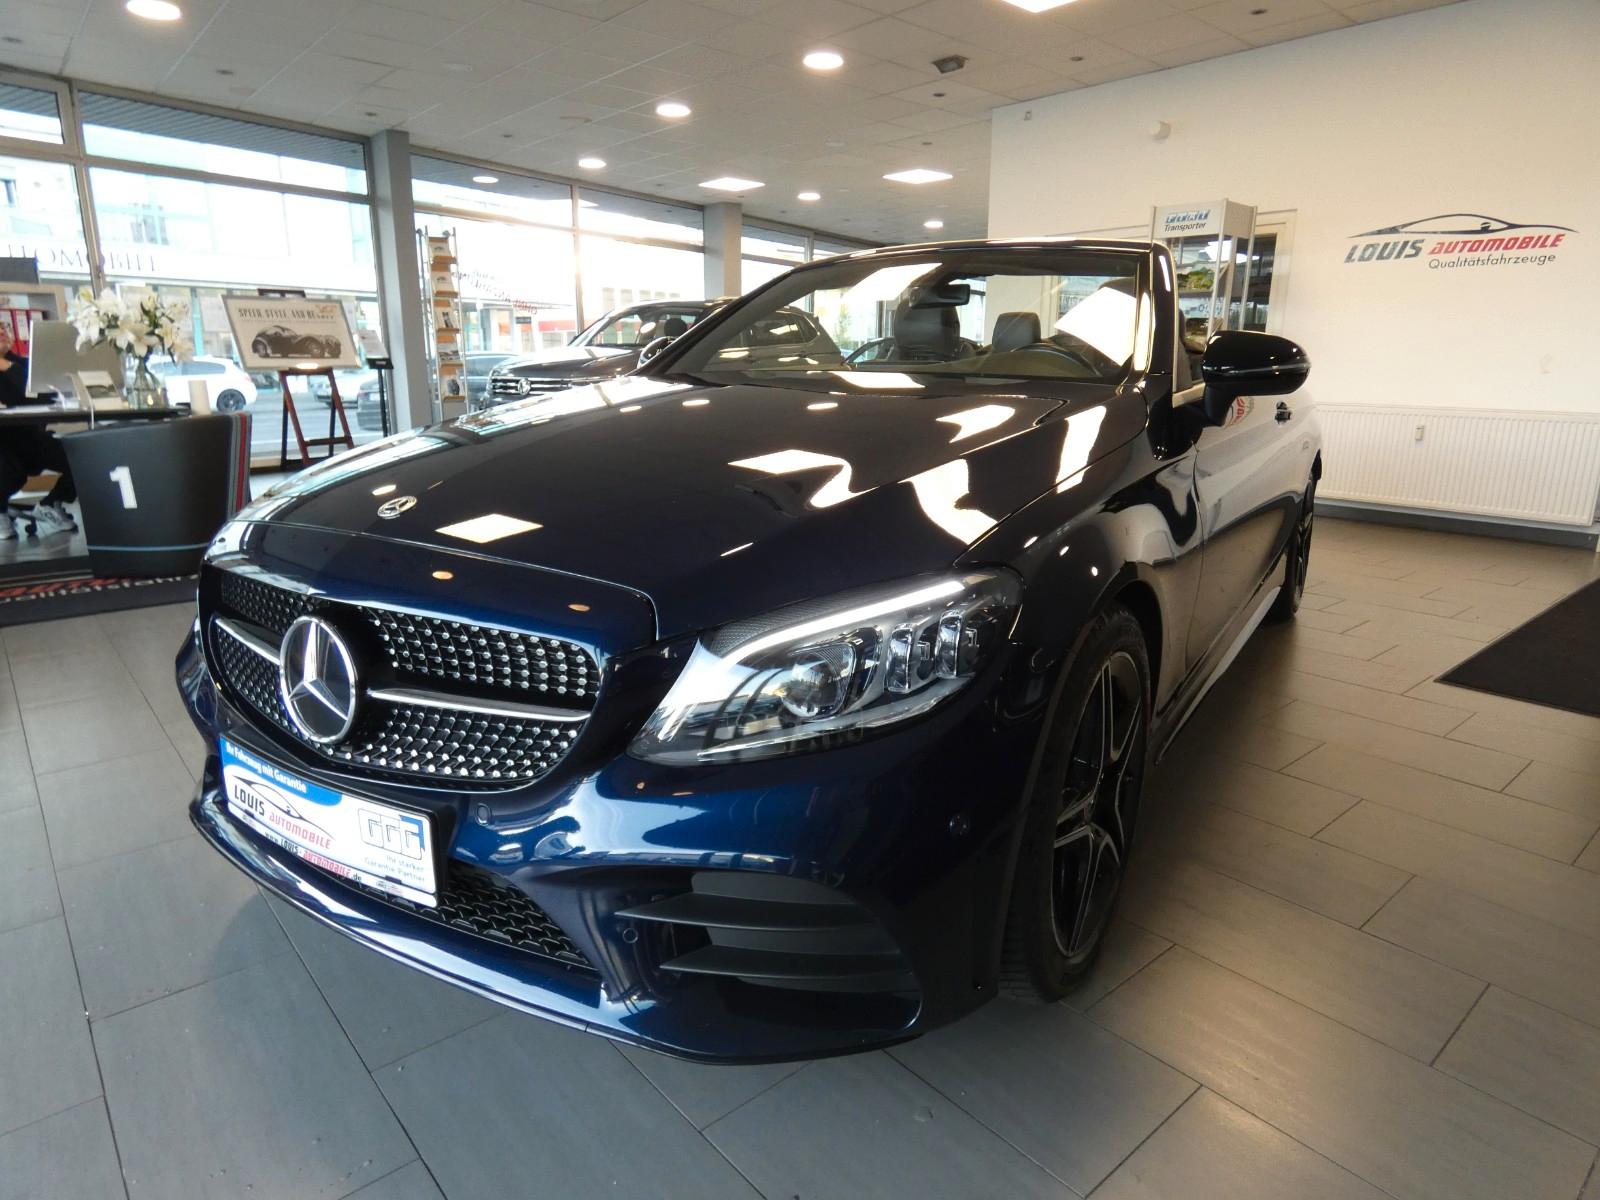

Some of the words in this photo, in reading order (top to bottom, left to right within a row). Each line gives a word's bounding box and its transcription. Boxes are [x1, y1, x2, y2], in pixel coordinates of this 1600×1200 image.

[1164, 222, 1207, 233] Transporter
[1344, 238, 1426, 264] LOUIS
[1428, 252, 1557, 270] Qualitätsfahrzeuge
[109, 465, 138, 509] 1
[234, 746, 262, 775] Fahrzeug
[262, 765, 275, 779] mit
[274, 769, 307, 794] Garantie
[234, 784, 265, 817] LOUIS
